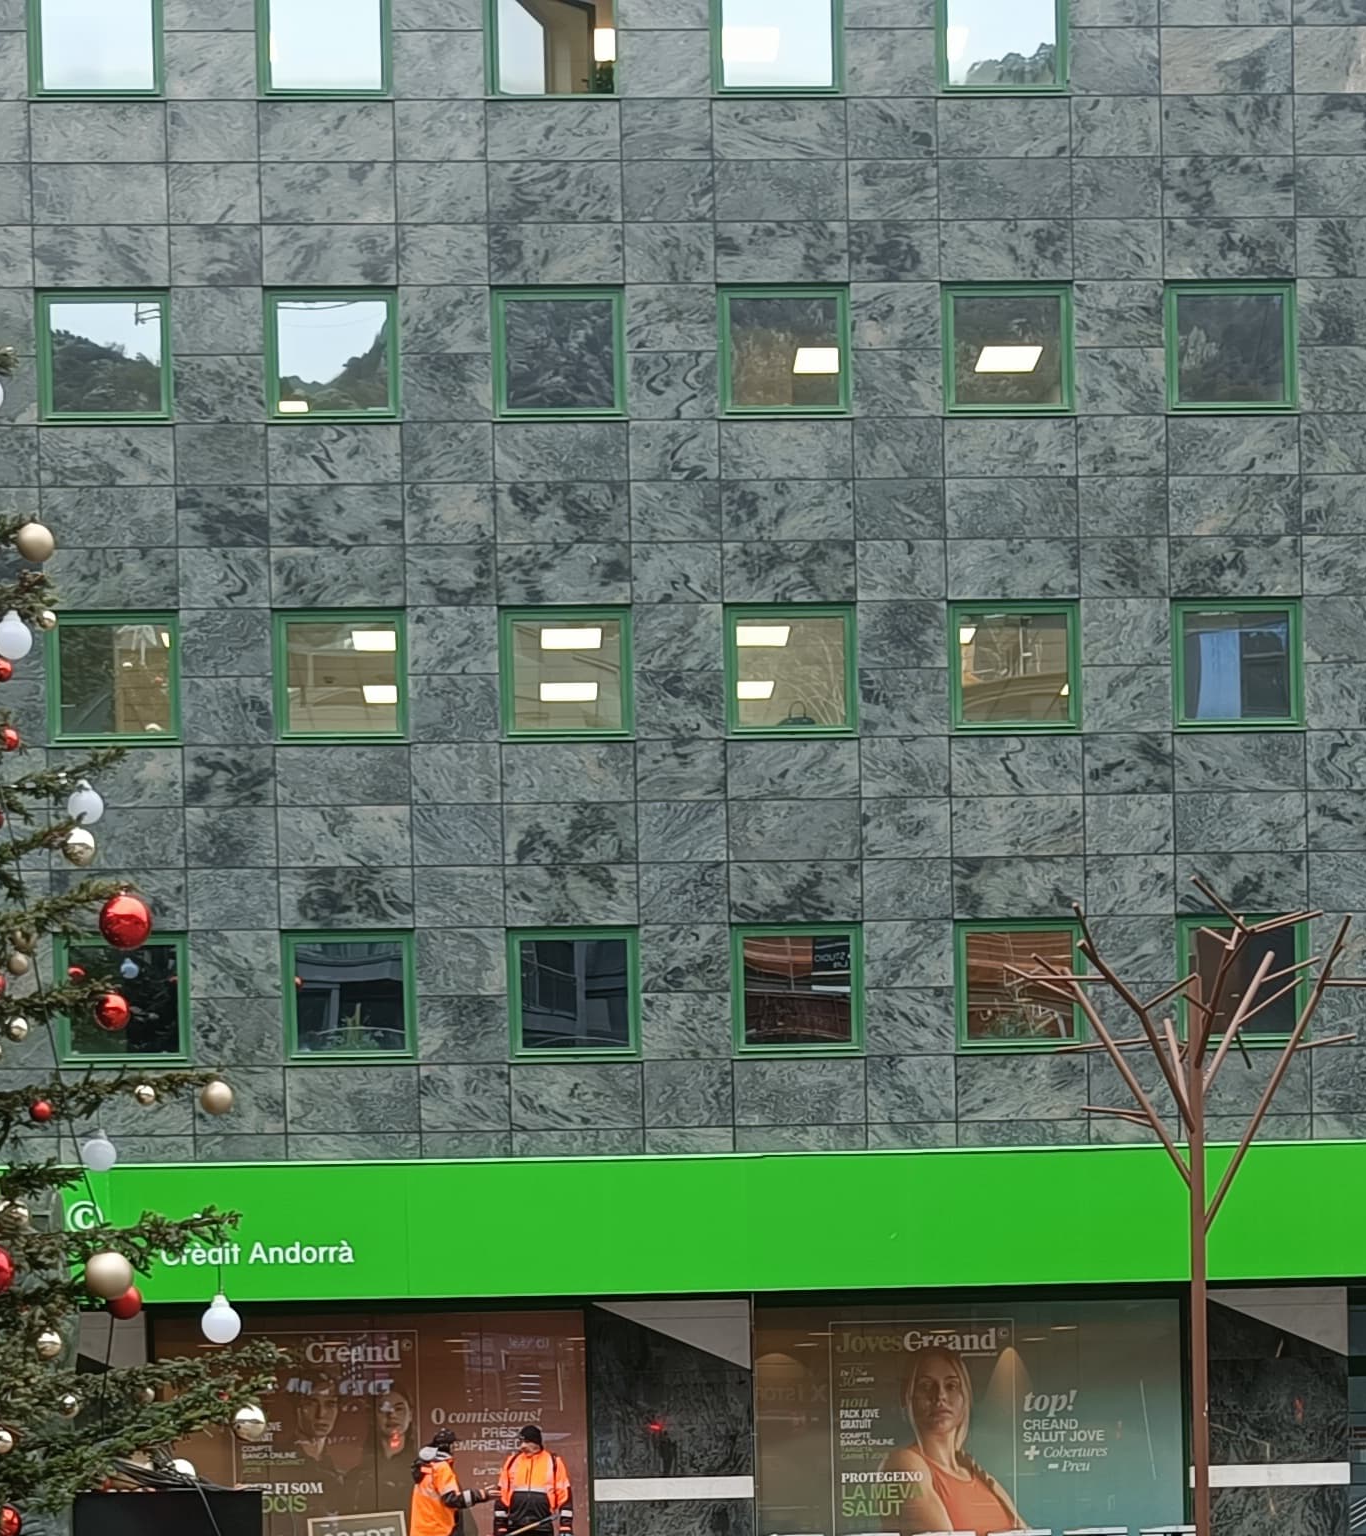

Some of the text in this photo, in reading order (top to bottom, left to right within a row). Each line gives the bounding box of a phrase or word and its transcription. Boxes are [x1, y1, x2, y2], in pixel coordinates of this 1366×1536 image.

[248, 1240, 355, 1265] Andorrà
[1023, 1390, 1077, 1417] top!
[448, 1408, 542, 1423] comissions!
[840, 1408, 881, 1419] PACK JOVE
[1023, 1419, 1078, 1430] CREAND
[1023, 1430, 1105, 1442] SALUT JOVE
[1043, 1446, 1108, 1458] Cobertures
[1062, 1461, 1090, 1472] Preu
[841, 1472, 923, 1483] PROTEGEIXO
[290, 1482, 323, 1494] SOM
[842, 1483, 923, 1500] LA MEVA
[262, 1495, 308, 1513] OCIS
[842, 1501, 904, 1517] SALUT
